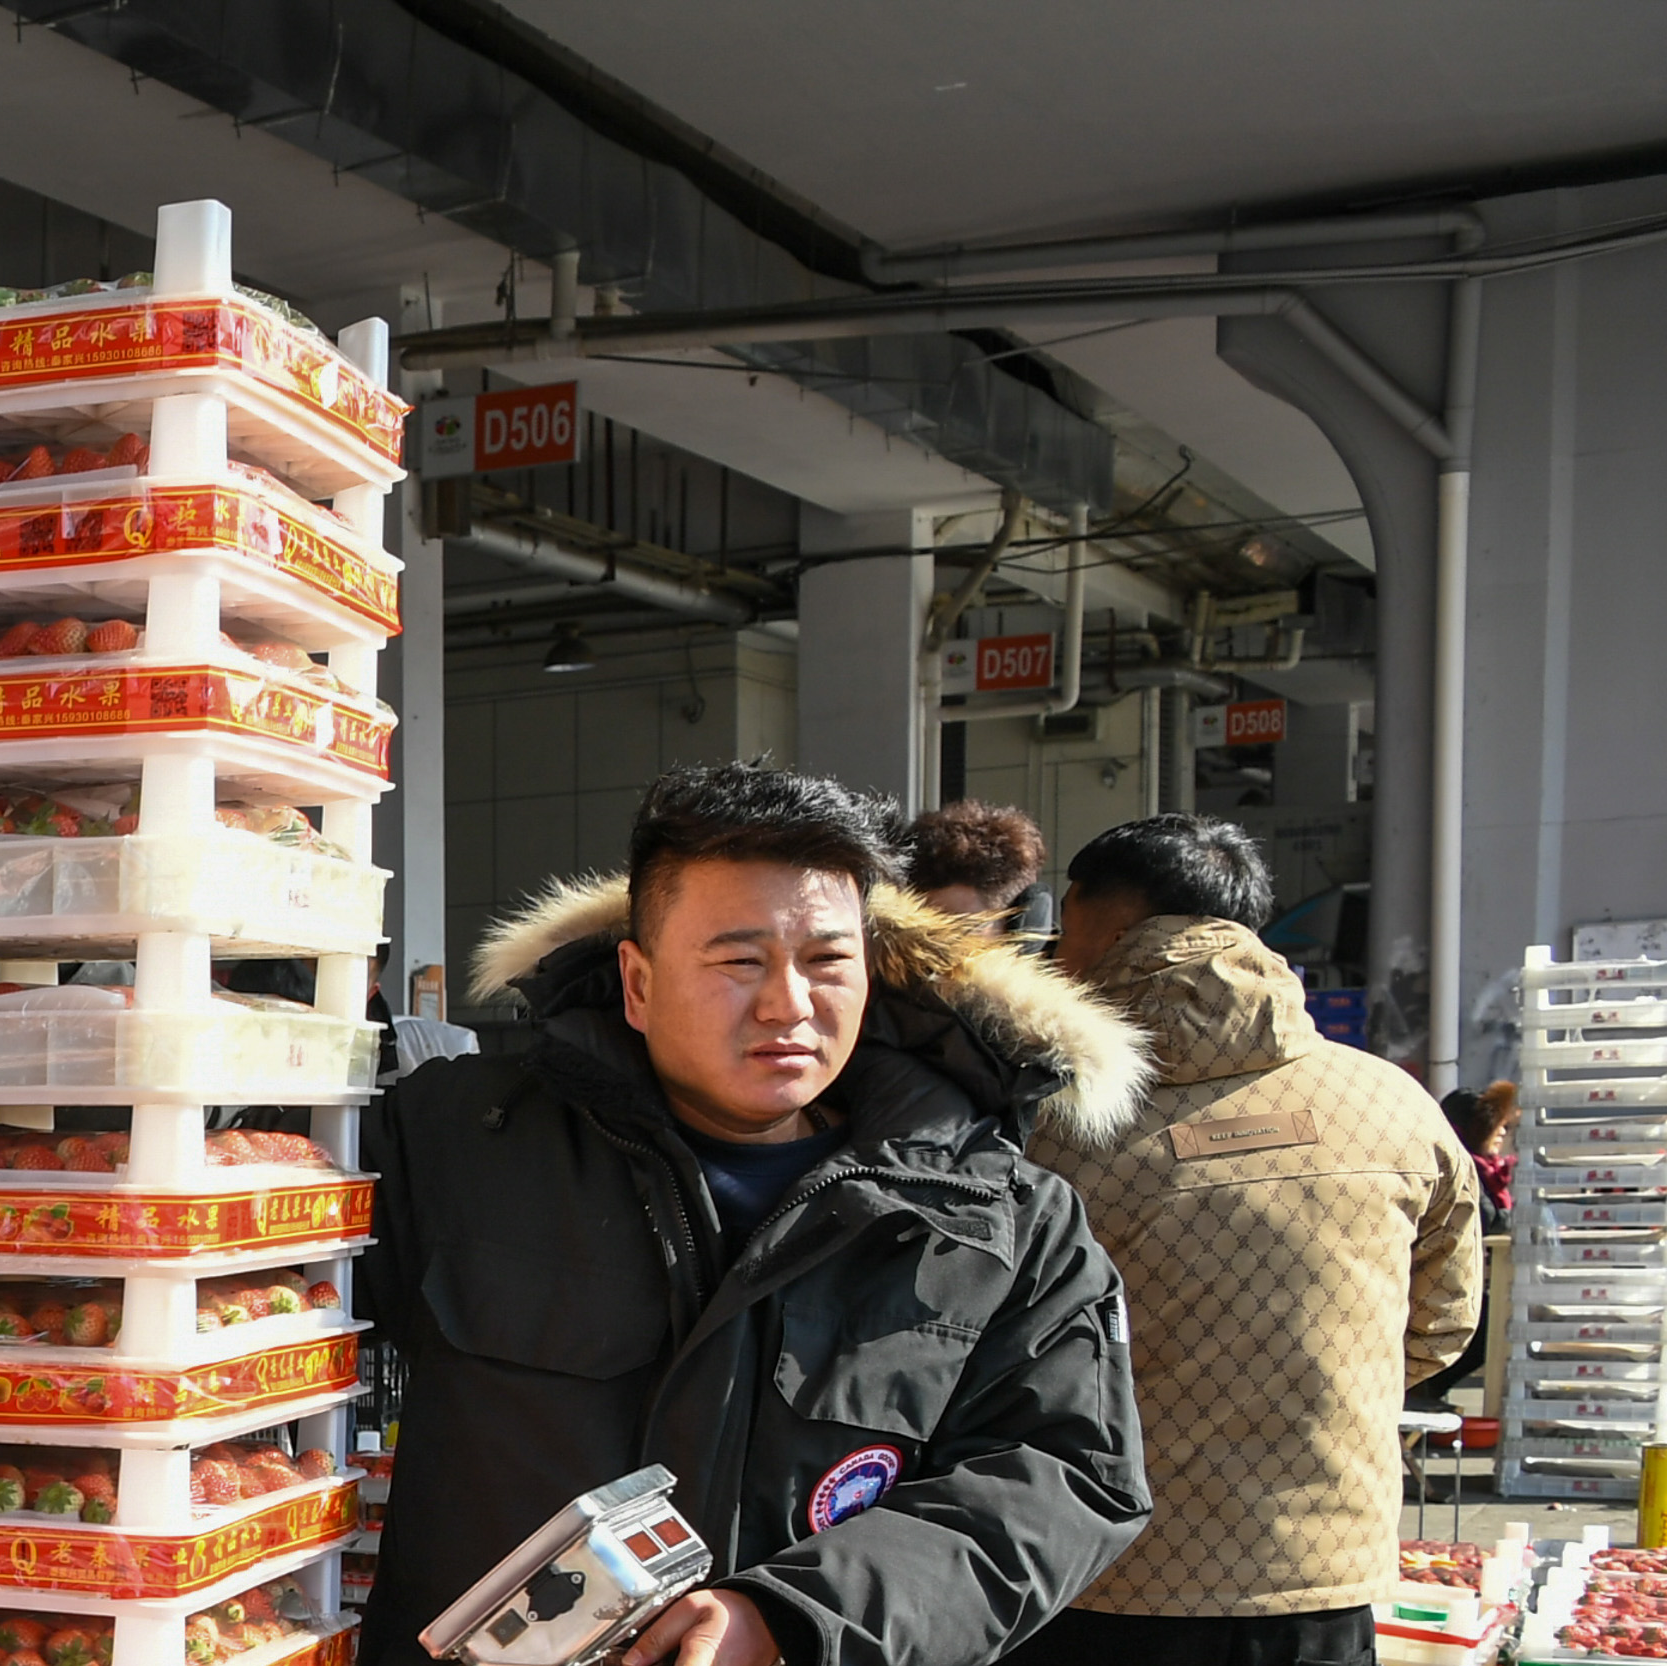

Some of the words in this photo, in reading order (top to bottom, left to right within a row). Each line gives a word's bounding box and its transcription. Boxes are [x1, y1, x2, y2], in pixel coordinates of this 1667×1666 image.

[9, 320, 156, 357] 精品水果
[483, 402, 570, 456] D506
[983, 643, 1050, 681] D507
[1229, 706, 1284, 738] D508
[839, 1453, 874, 1474] CANADA
[10, 1536, 39, 1575] Q
